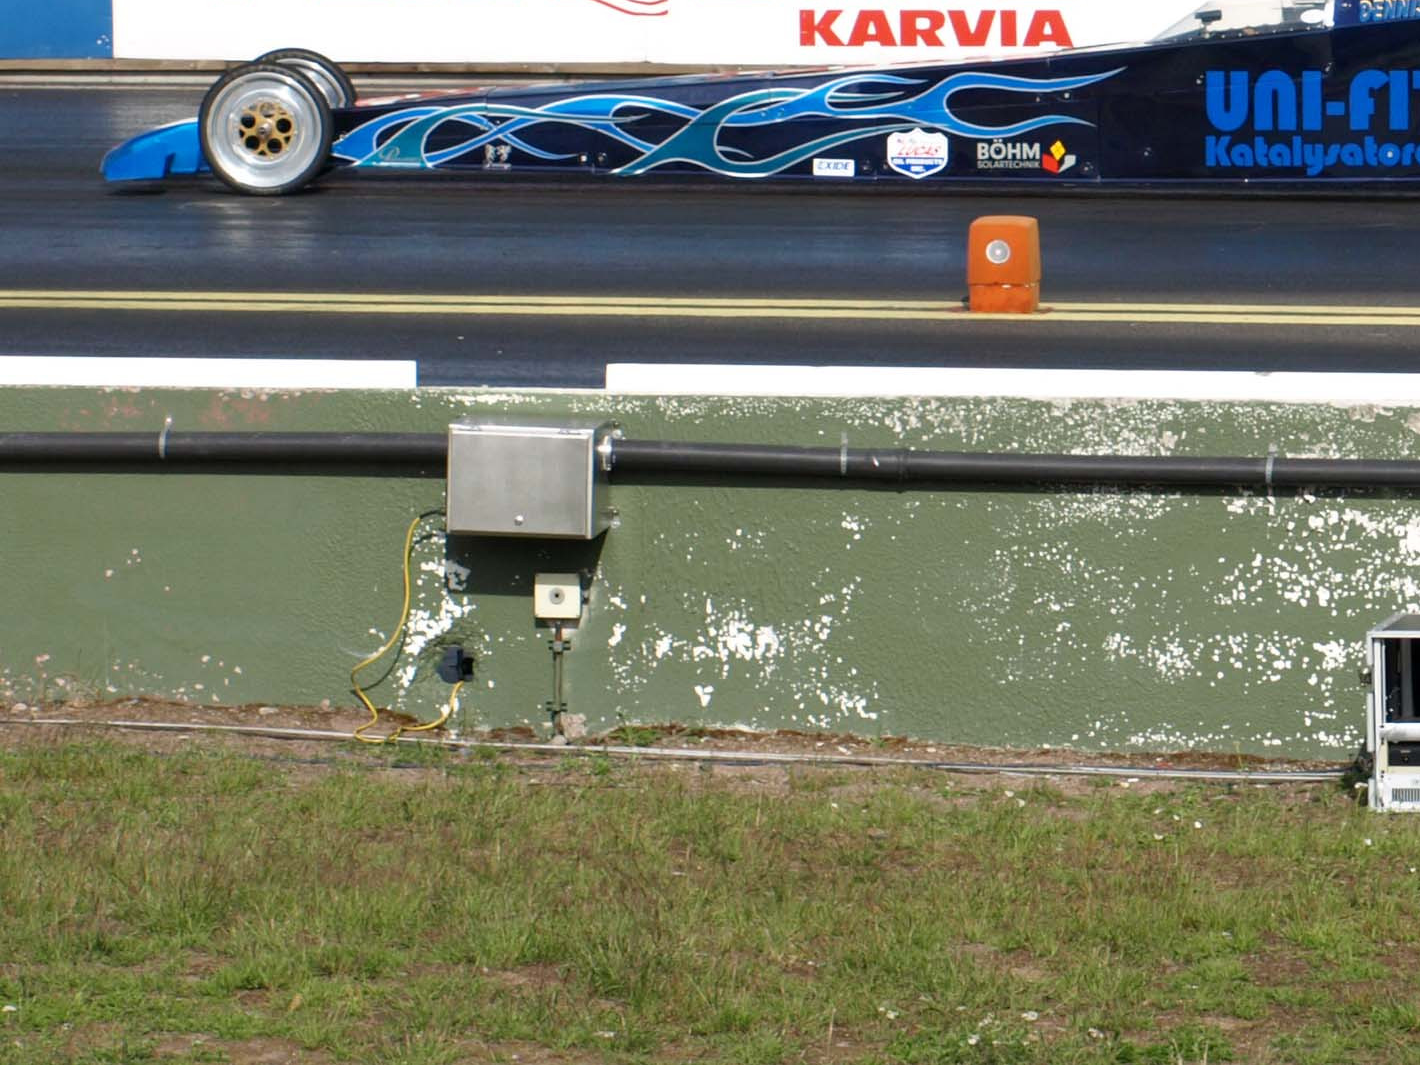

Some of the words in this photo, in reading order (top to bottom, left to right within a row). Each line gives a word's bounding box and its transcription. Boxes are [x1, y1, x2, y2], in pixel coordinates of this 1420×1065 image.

[799, 9, 1074, 48] KARVIA
[976, 138, 1041, 160] BÖHM
[817, 159, 851, 171] EXIDE
